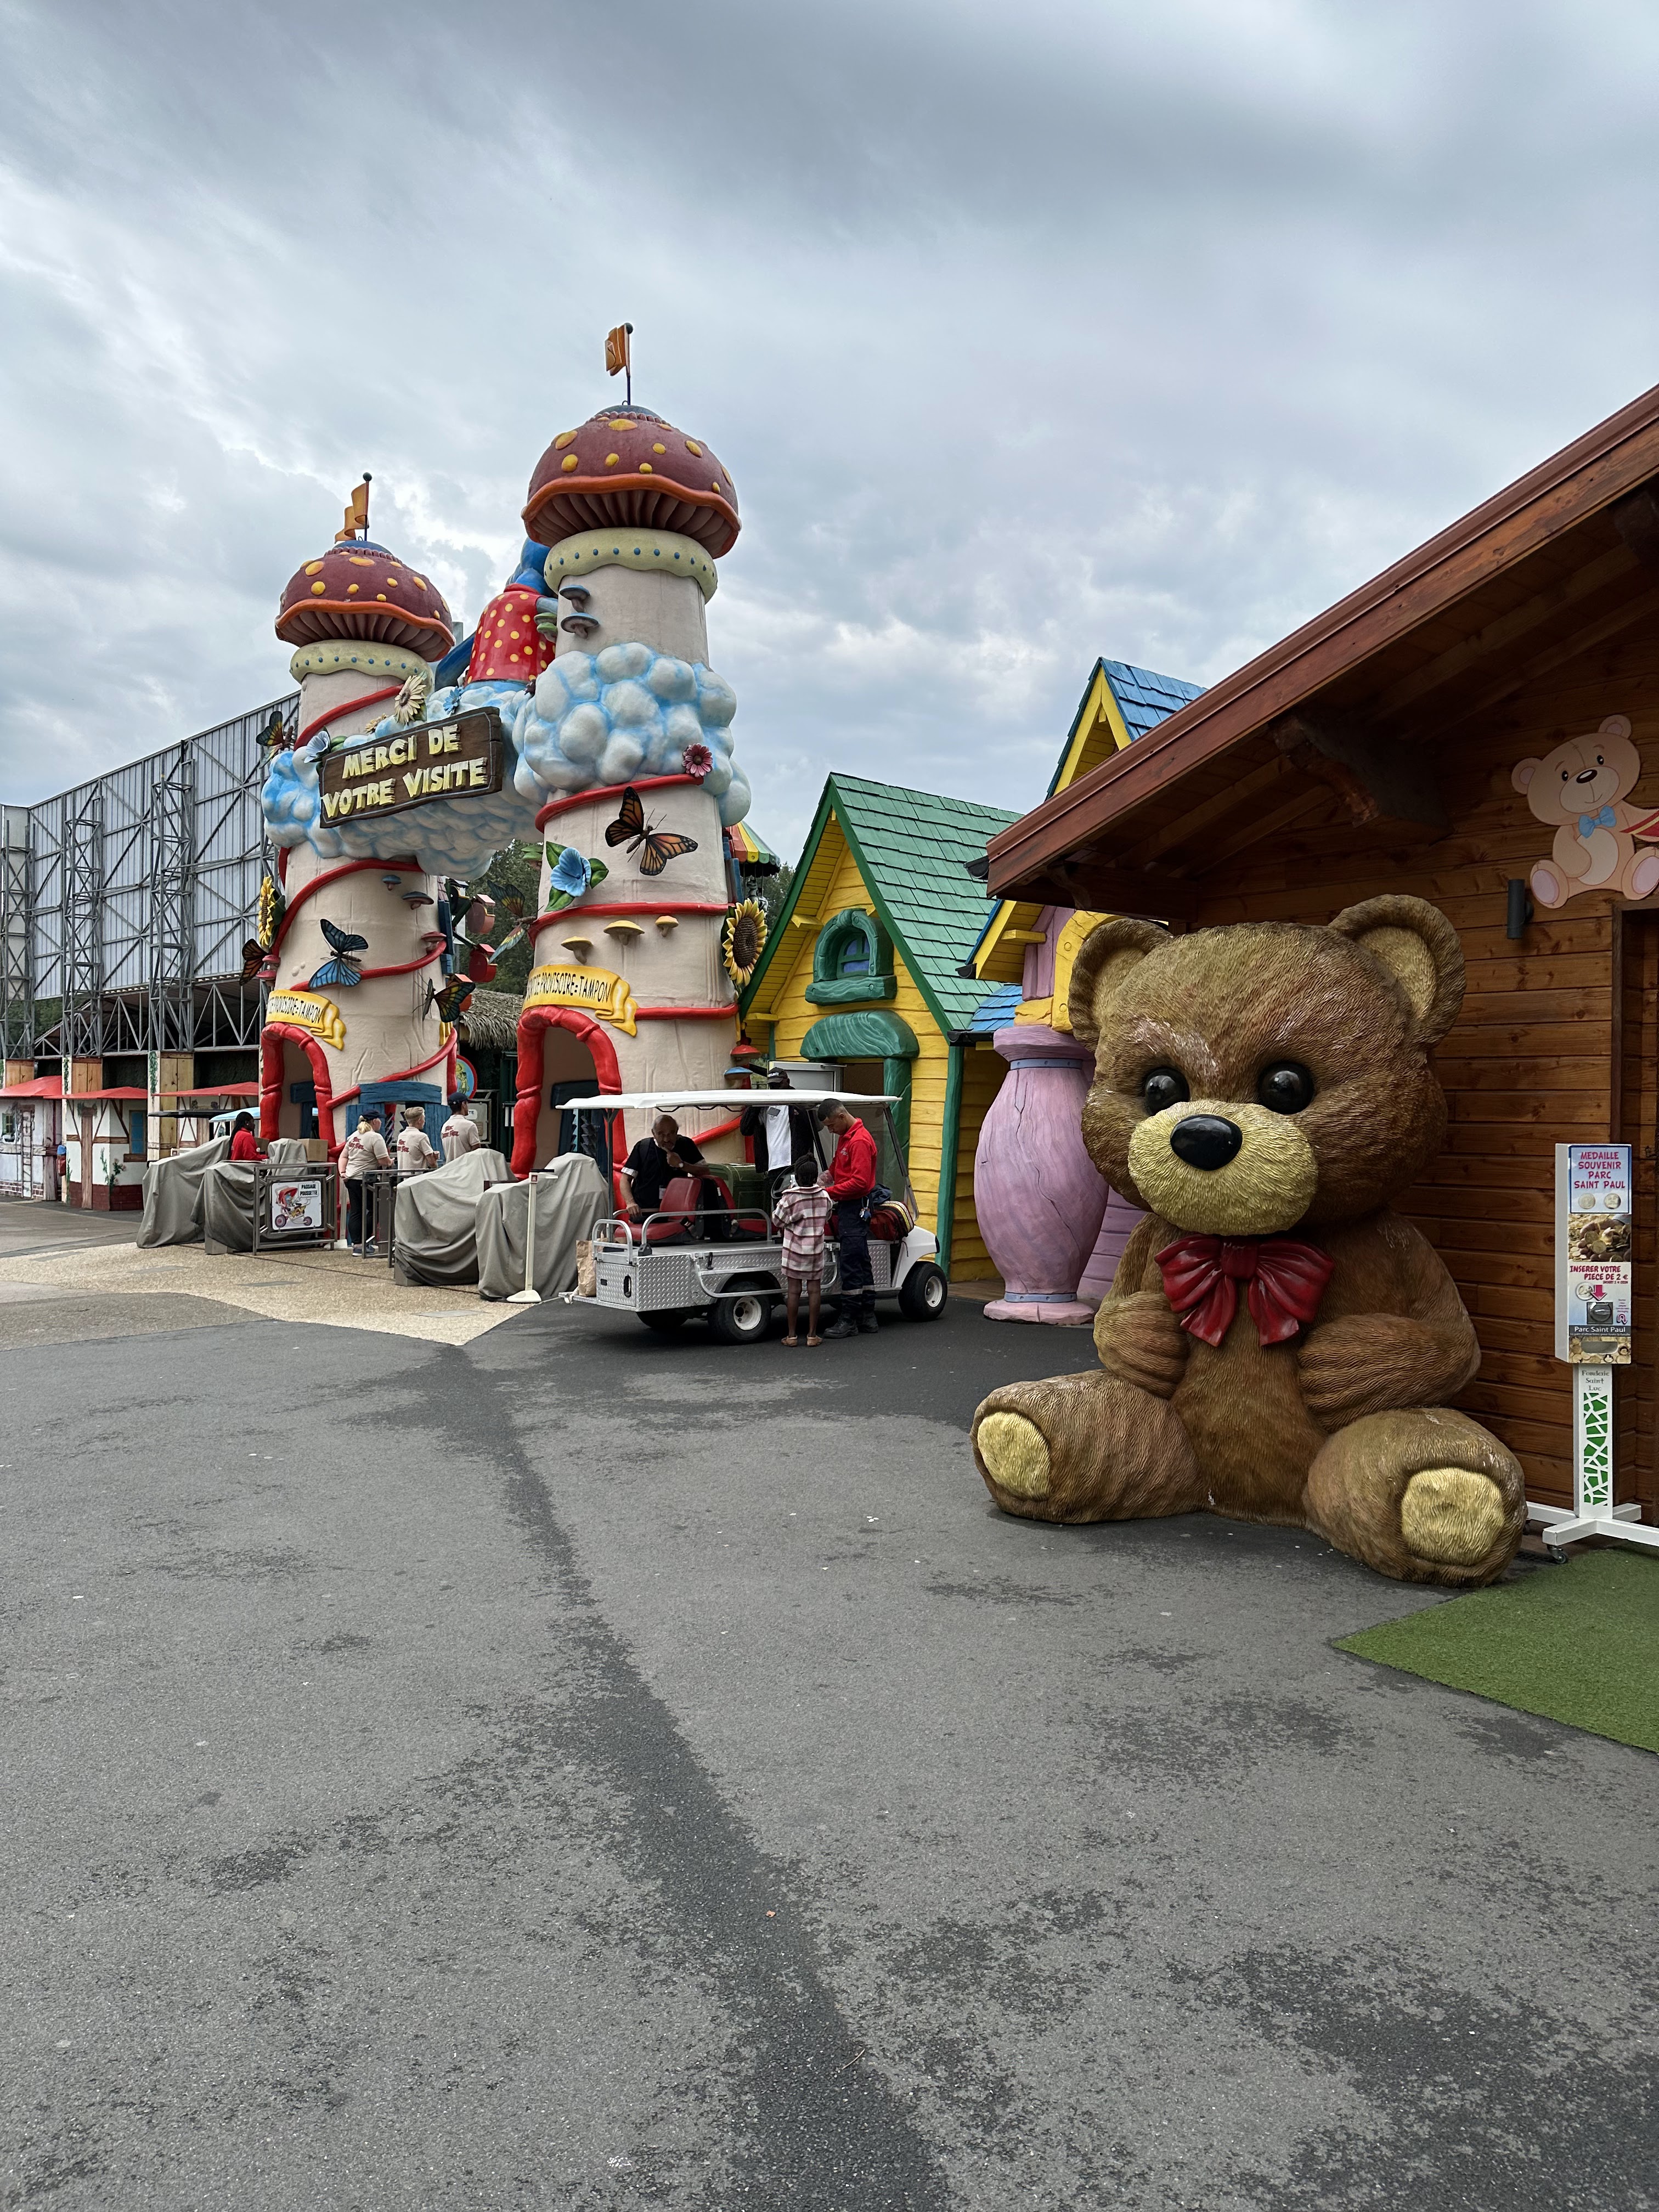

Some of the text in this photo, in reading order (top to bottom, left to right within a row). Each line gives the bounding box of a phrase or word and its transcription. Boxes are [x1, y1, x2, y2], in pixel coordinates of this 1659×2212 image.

[342, 724, 462, 780] MERCI DE
[321, 757, 488, 818] VOTRE VISITE
[579, 976, 612, 1003] TAMPON
[298, 1000, 324, 1024] TAMPON
[1581, 1152, 1619, 1160] MEDAILLE
[1574, 1181, 1625, 1189] SAINT PAUL
